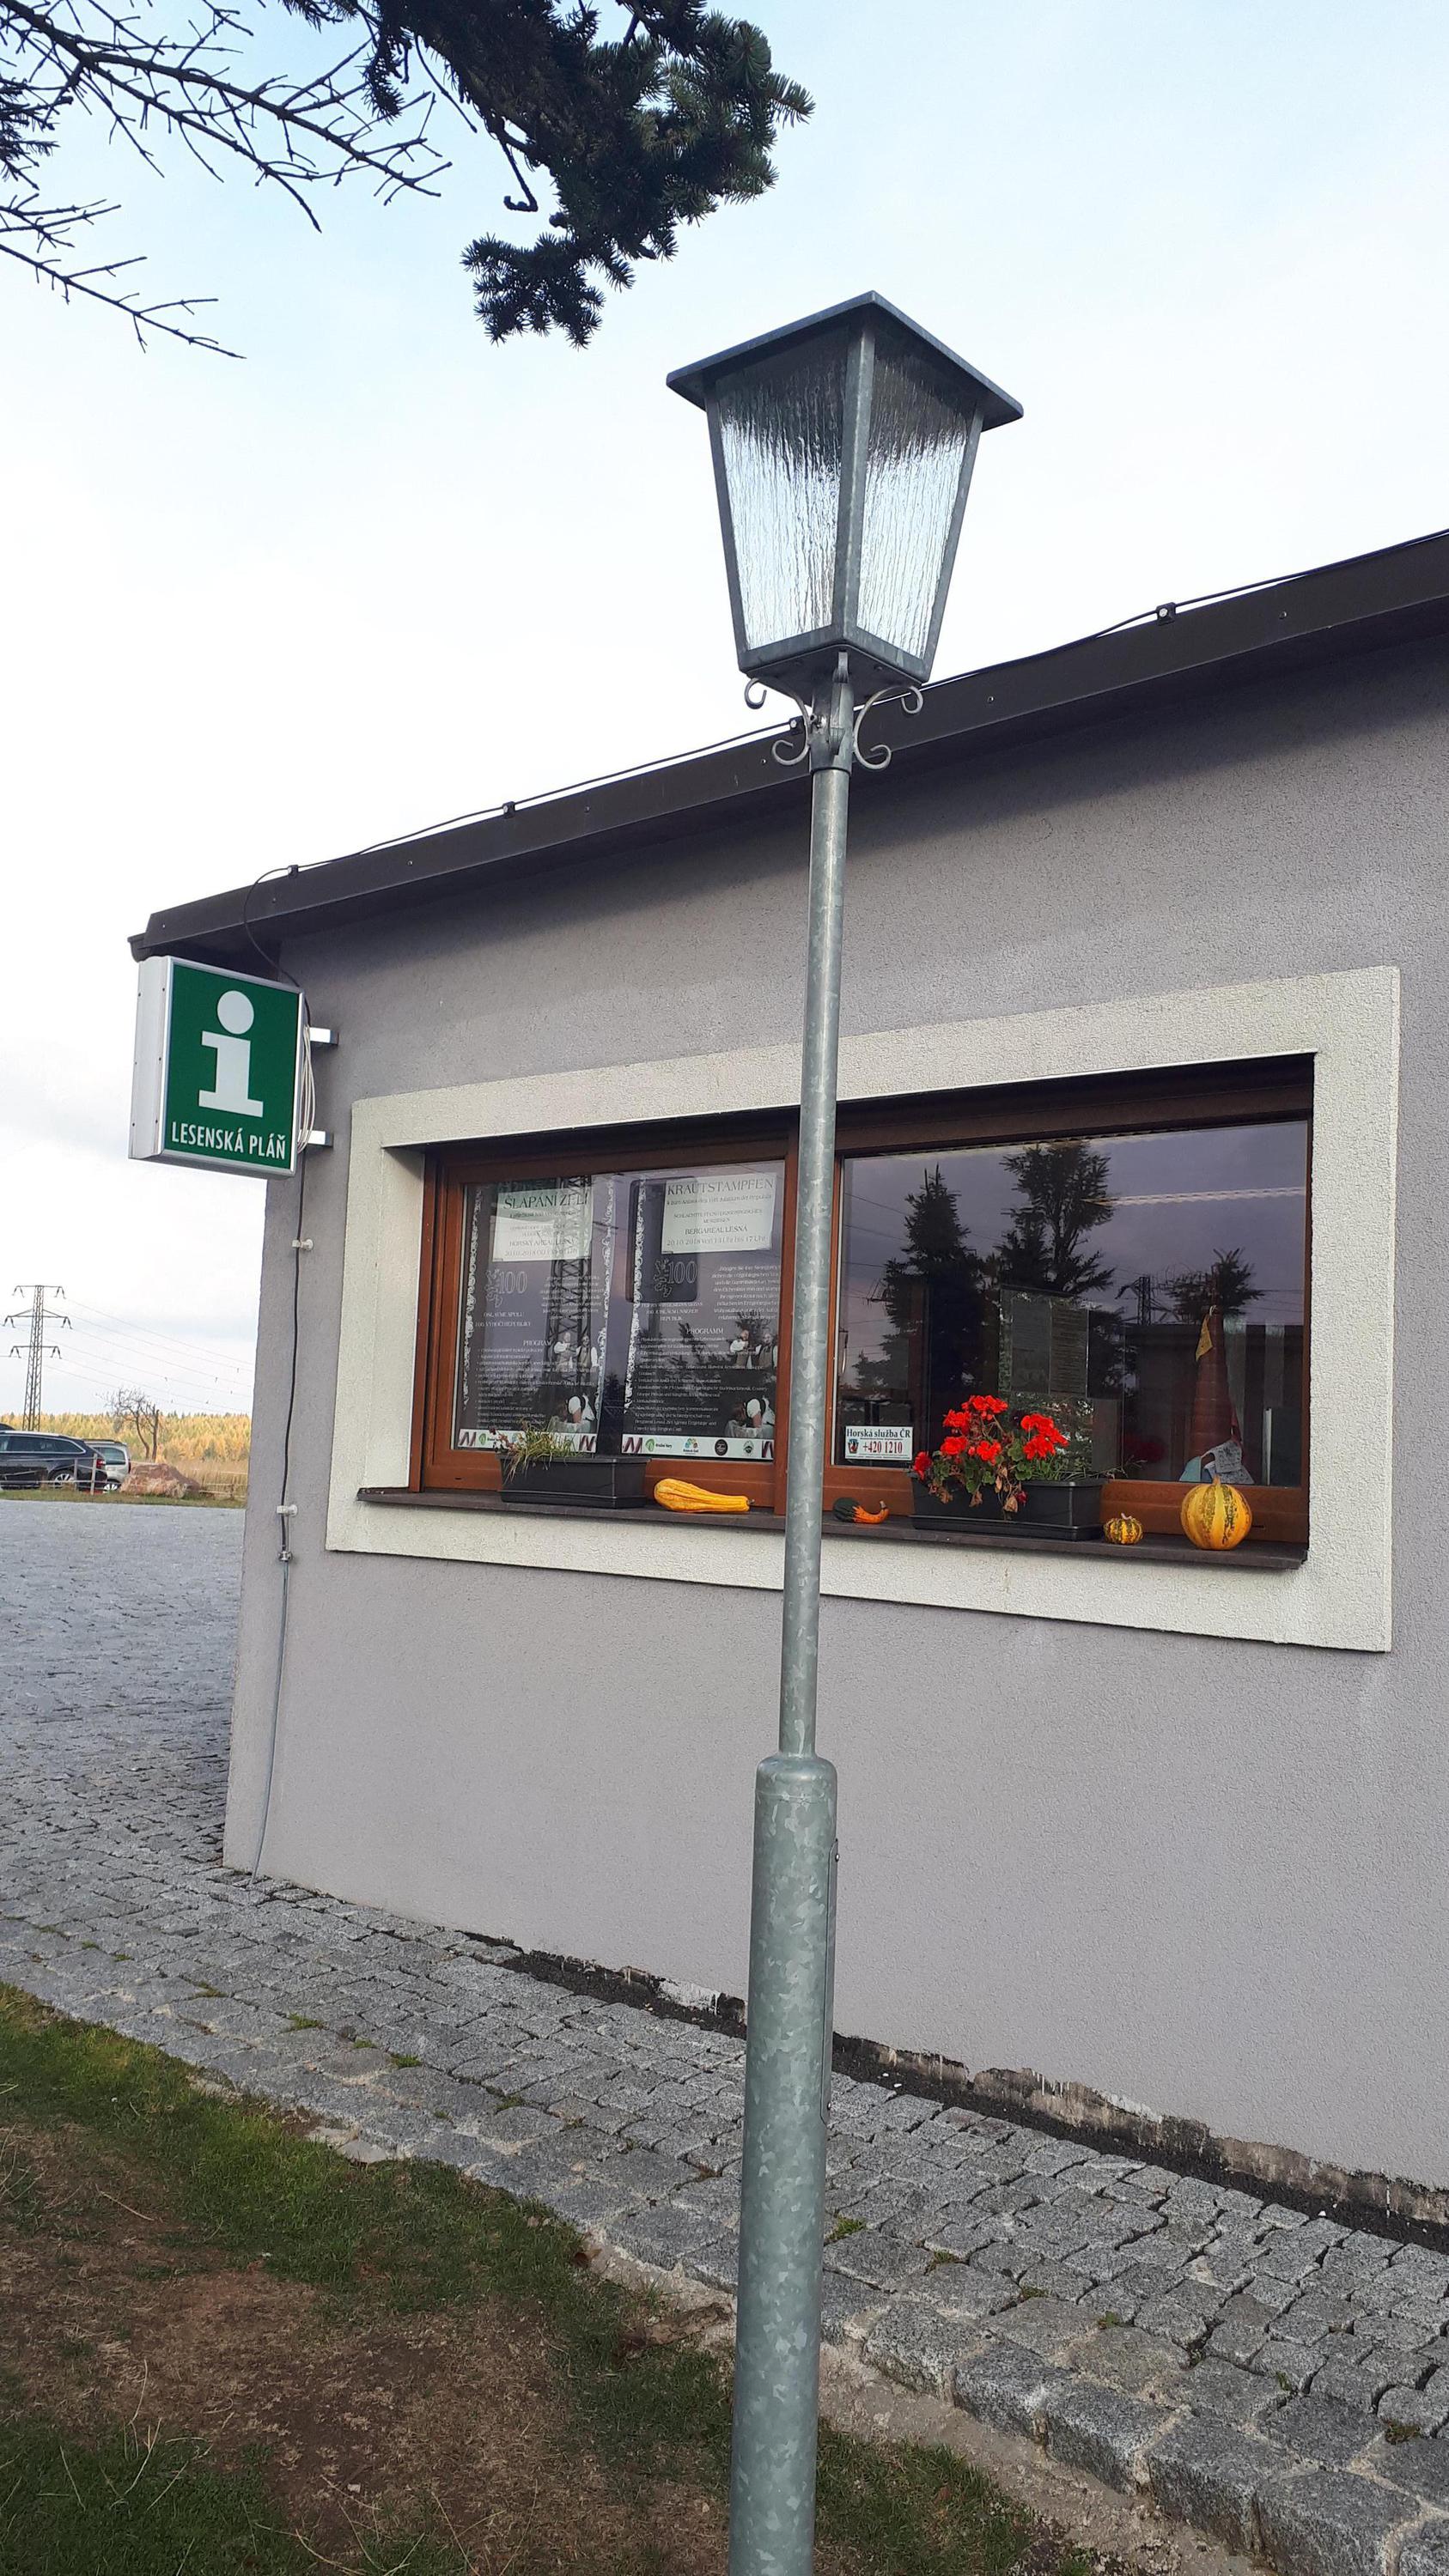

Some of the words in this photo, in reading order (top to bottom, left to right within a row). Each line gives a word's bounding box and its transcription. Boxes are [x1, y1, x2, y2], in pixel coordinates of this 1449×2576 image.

[172, 1121, 244, 1153] LESENSKÁ
[249, 1133, 286, 1160] PLÁŇ
[667, 1178, 774, 1195] KRAUTSTAMPFEN
[504, 1193, 557, 1209] ŠLAPÁNÍ
[685, 1226, 724, 1236] BERGAREAL
[668, 1261, 697, 1284] 100
[499, 1271, 527, 1294] 100
[687, 1327, 723, 1335] PROGRAMM
[847, 1429, 873, 1437] Horská
[874, 1429, 898, 1437] služba
[899, 1428, 910, 1437] ČR
[862, 1440, 882, 1453] +420
[885, 1441, 903, 1454] 1210
